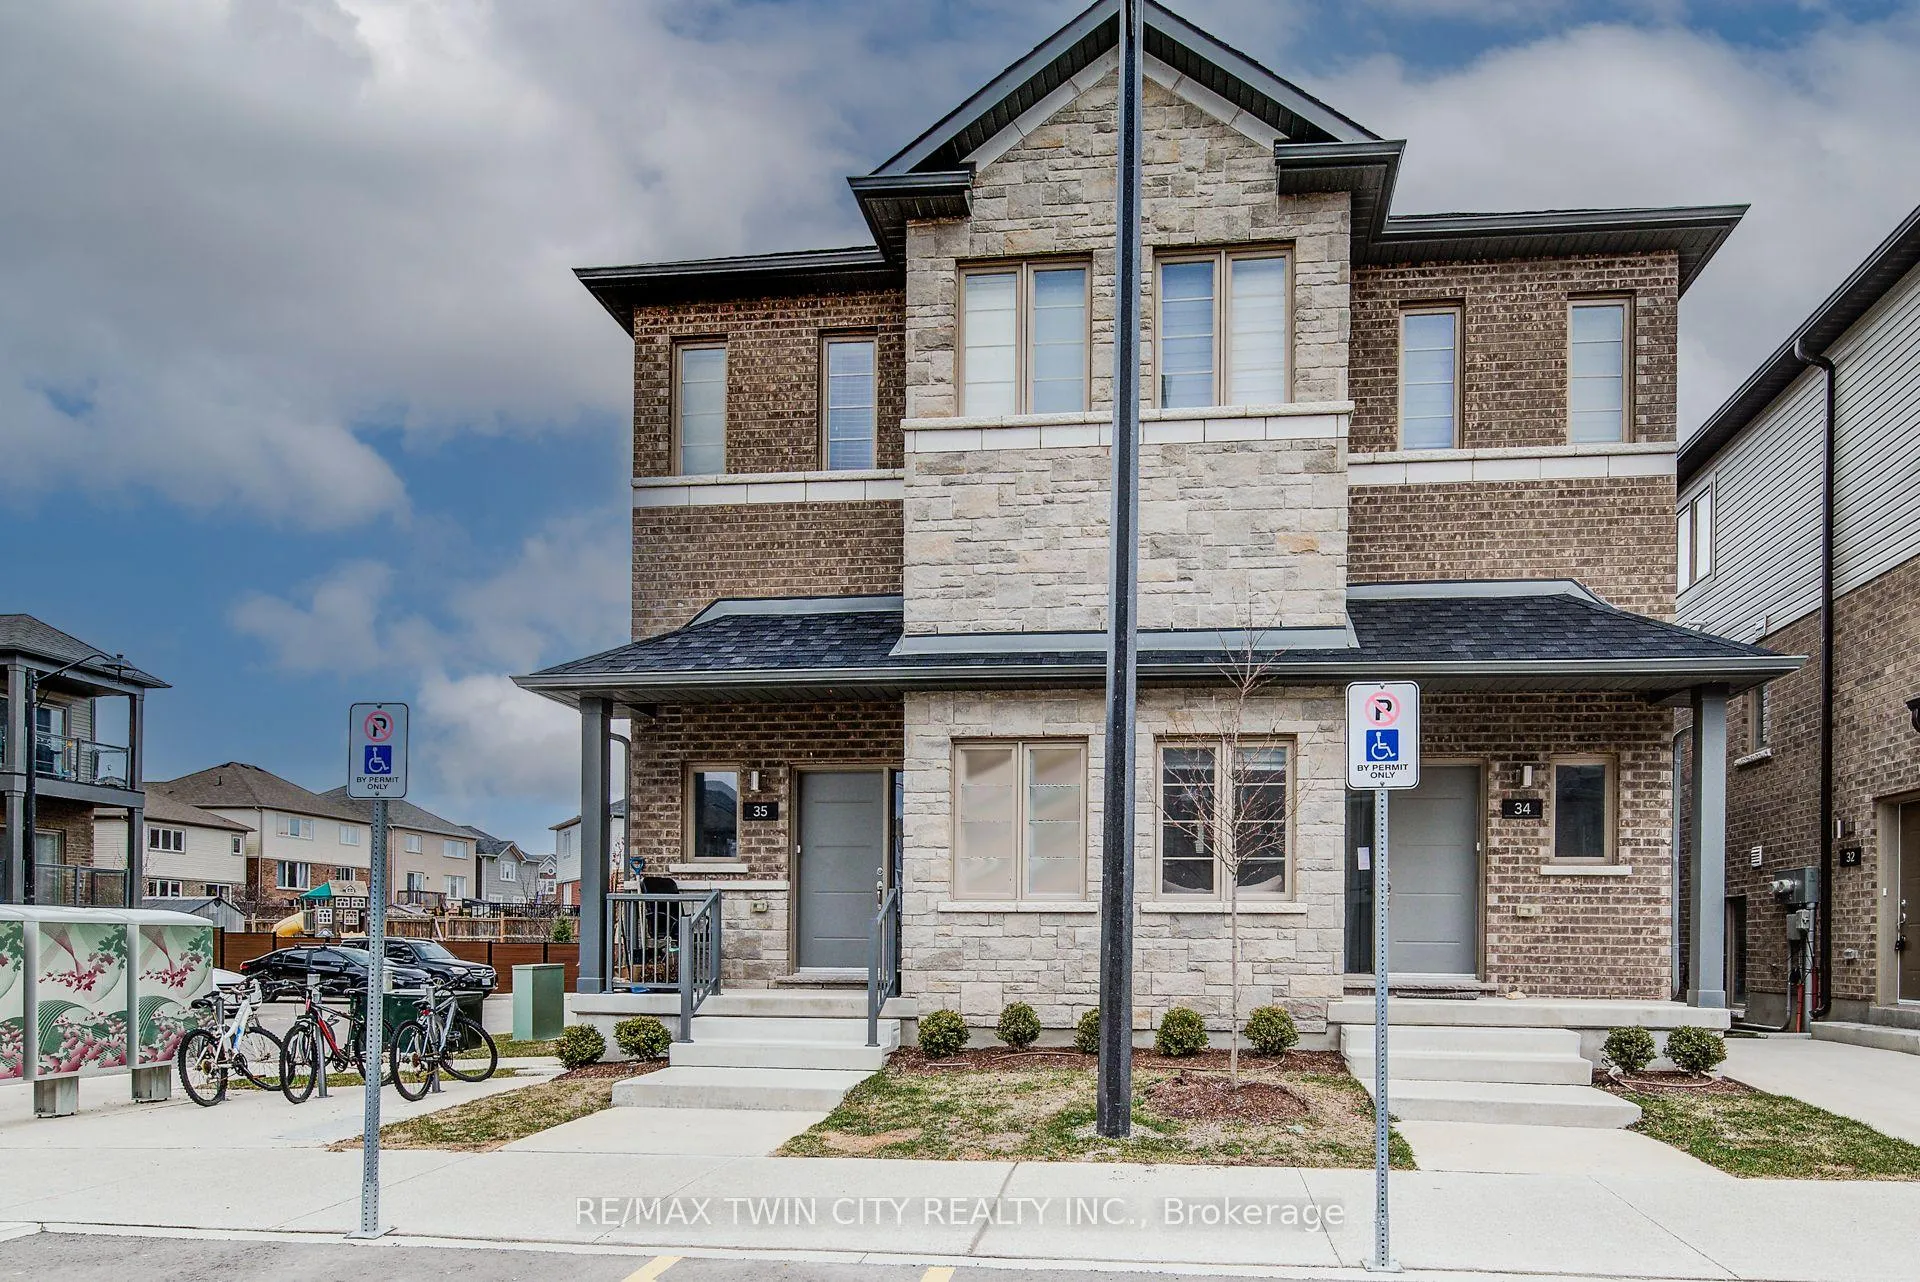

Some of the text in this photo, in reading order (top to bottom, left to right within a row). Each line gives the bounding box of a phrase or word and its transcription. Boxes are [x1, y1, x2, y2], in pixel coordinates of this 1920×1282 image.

[1357, 763, 1408, 772] BY PERMIT
[1370, 771, 1396, 779] ONLY
[753, 805, 768, 817] 35
[1514, 802, 1531, 815] 34
[1846, 851, 1856, 863] 32
